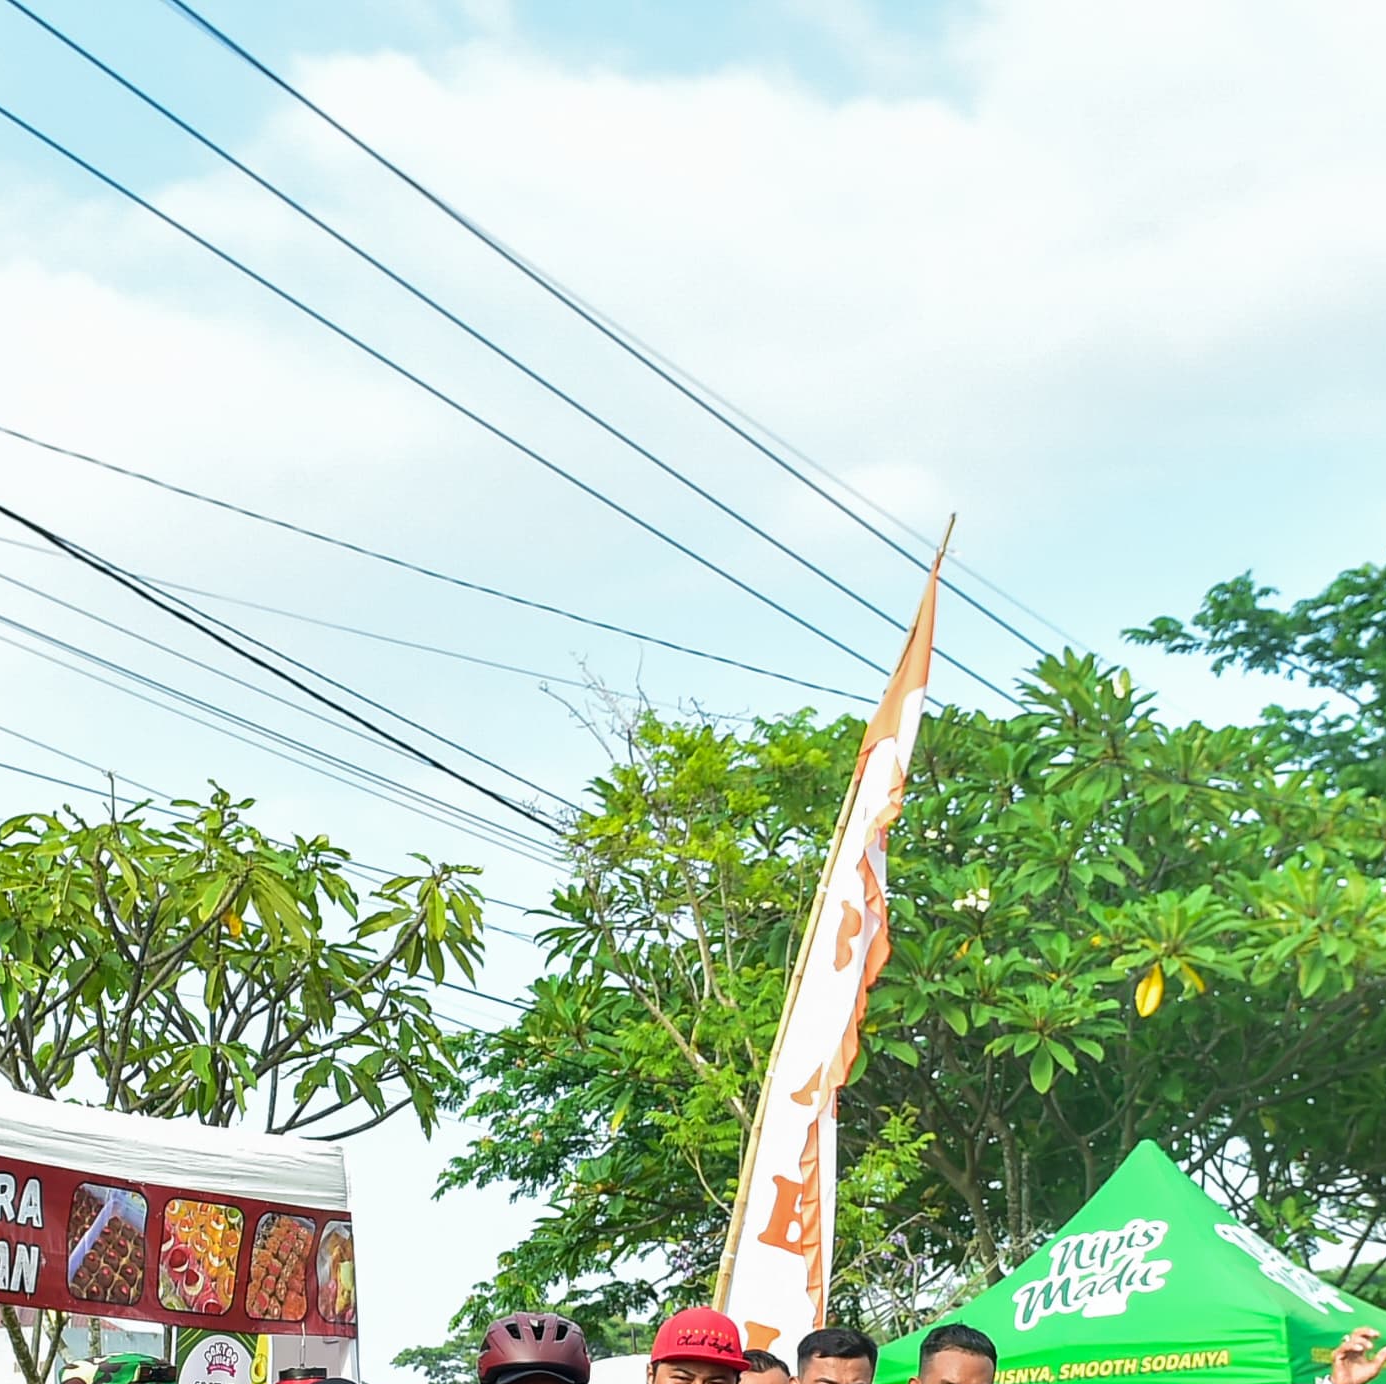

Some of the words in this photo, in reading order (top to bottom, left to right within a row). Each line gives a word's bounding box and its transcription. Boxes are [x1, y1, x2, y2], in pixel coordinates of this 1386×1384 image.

[1057, 1223, 1160, 1276] Nipis
[1021, 1257, 1153, 1324] Madu
[1059, 1358, 1138, 1381] SMOOTH
[1140, 1350, 1230, 1375] SODANYA
